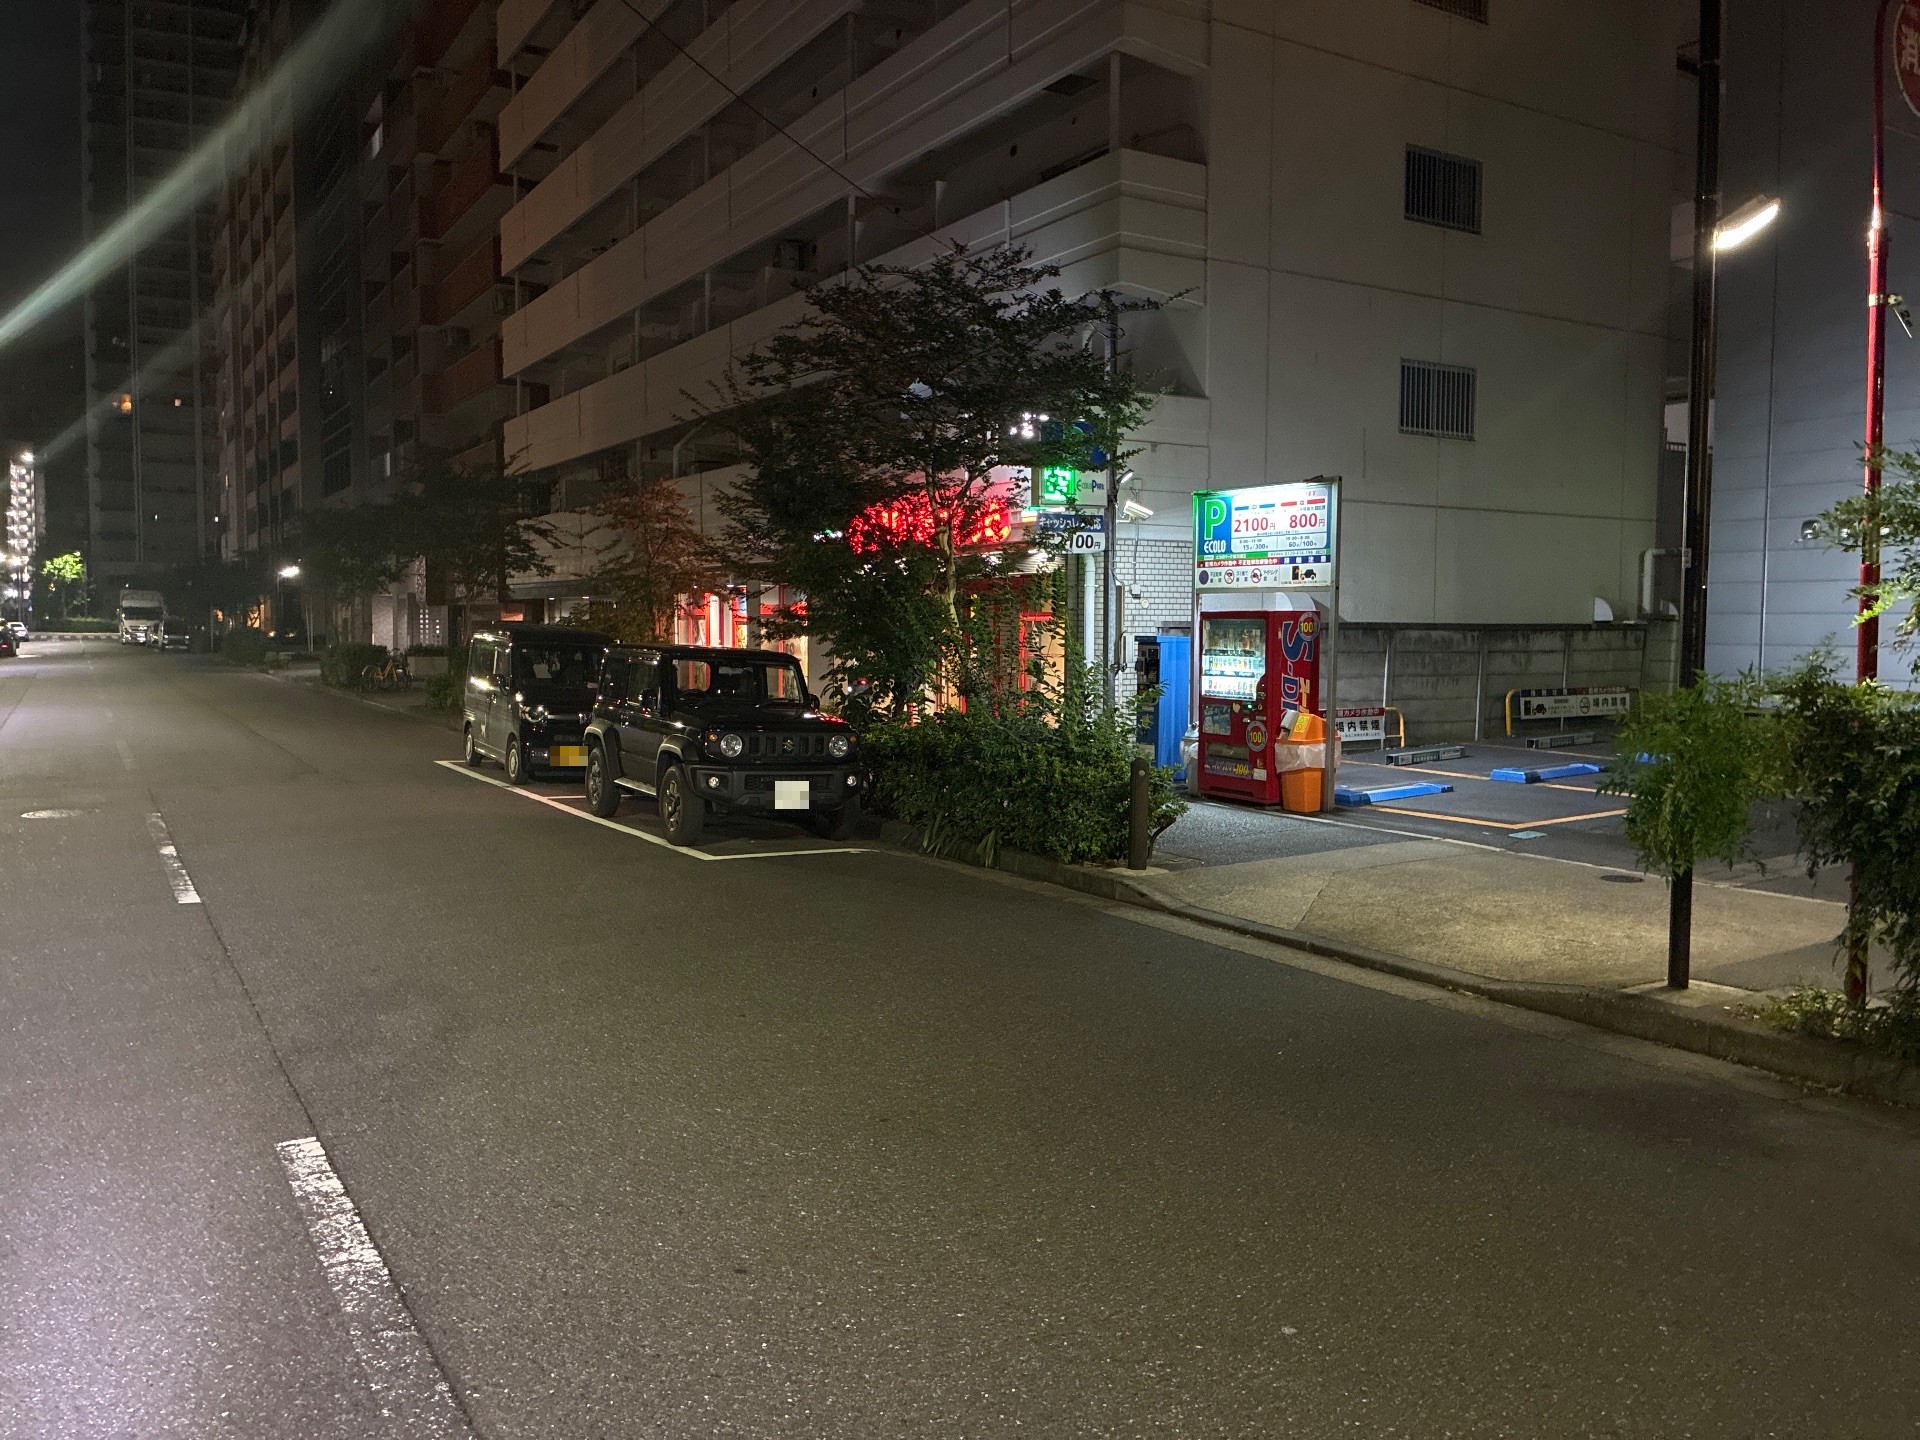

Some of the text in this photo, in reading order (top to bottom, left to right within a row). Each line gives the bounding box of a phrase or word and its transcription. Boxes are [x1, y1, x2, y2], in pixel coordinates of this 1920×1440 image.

[1204, 499, 1227, 540] P
[1233, 517, 1276, 533] 2100円
[1289, 513, 1326, 529] 800円
[1203, 540, 1227, 553] ECOLO
[1337, 708, 1380, 718] 視カメラ作動中
